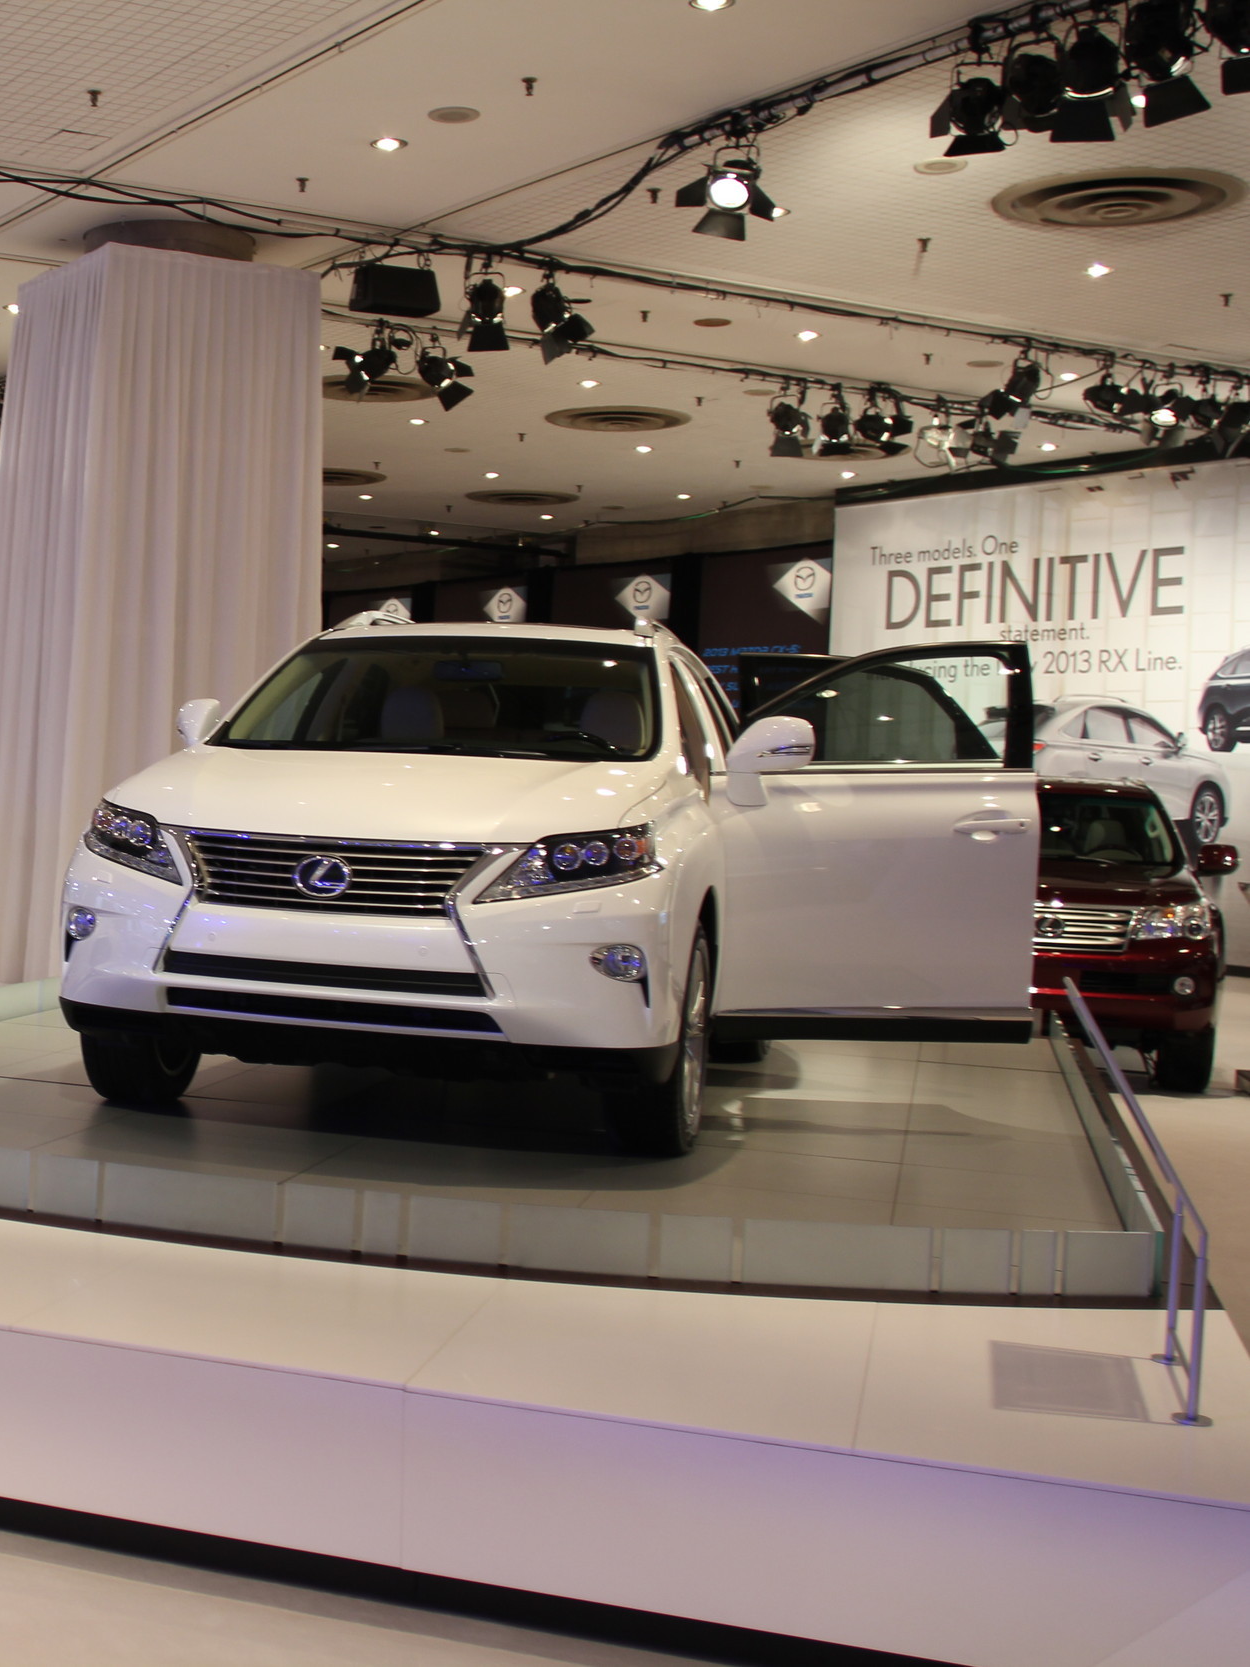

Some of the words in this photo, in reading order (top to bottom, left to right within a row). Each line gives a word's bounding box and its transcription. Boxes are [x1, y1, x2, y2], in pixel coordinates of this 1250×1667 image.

[870, 545, 913, 566] Three
[917, 538, 978, 562] models.
[981, 534, 1020, 556] One
[885, 546, 1185, 630] DEFINITIVE
[1000, 623, 1091, 642] statement.
[963, 657, 991, 678] the
[1043, 651, 1093, 675] 2013
[1098, 649, 1130, 673] RX
[1135, 647, 1184, 671] Line.
